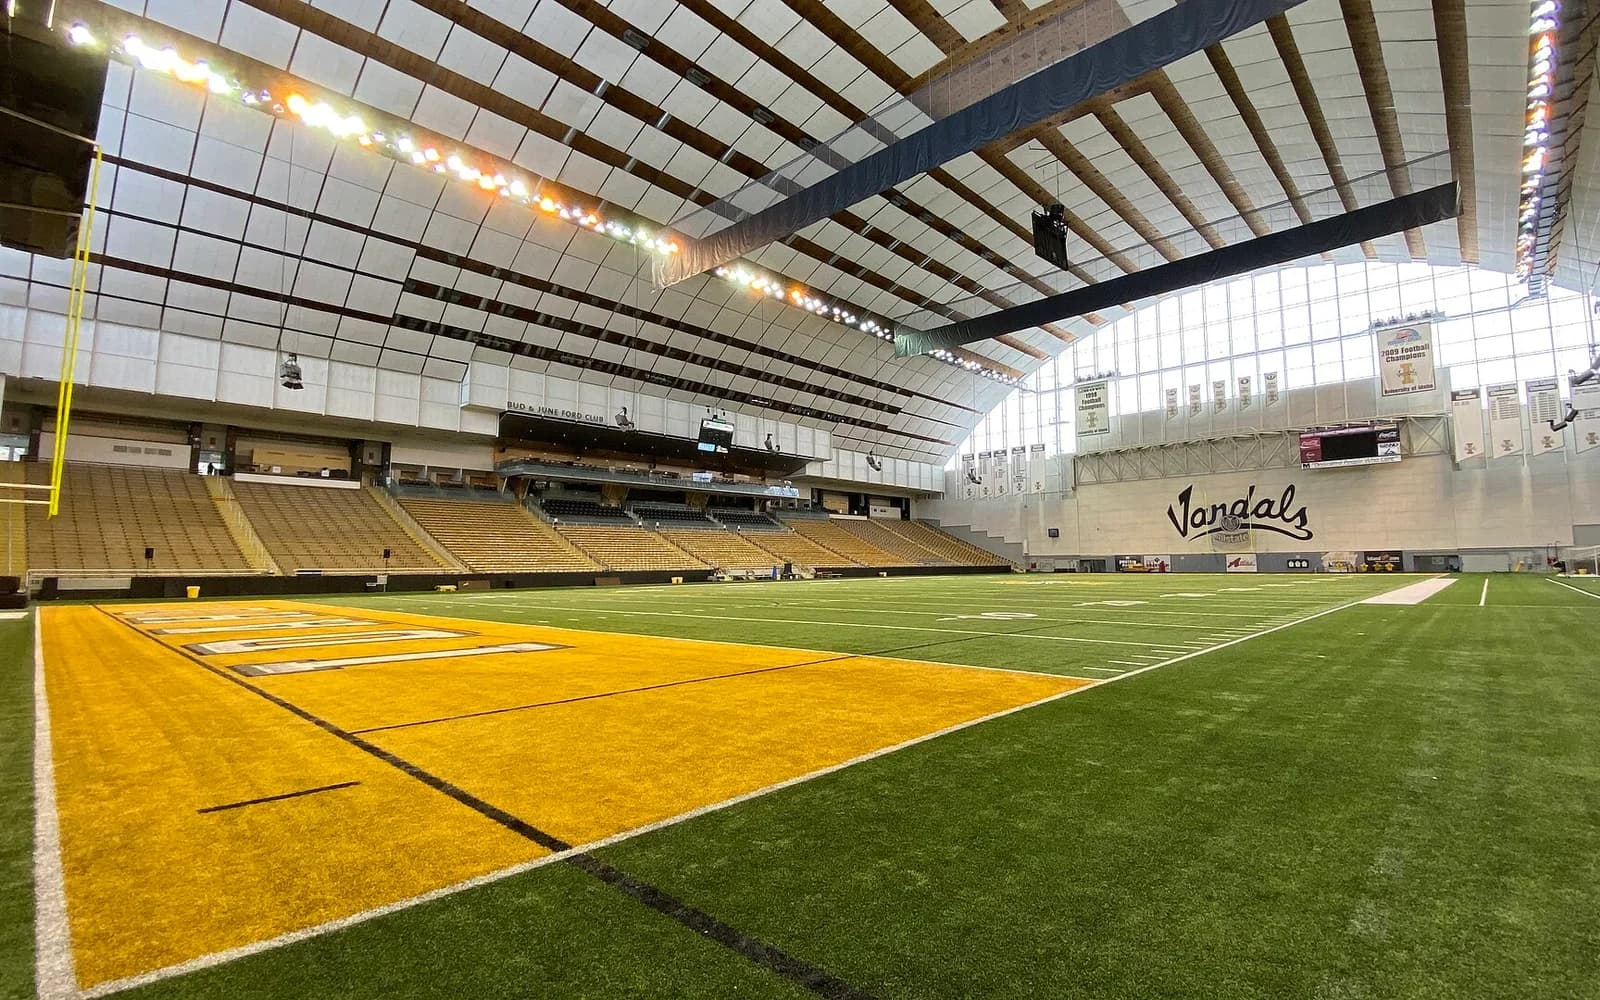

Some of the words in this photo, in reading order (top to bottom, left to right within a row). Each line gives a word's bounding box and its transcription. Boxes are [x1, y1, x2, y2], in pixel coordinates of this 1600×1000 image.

[1381, 348, 1398, 357] 2009
[1401, 344, 1429, 353] Football
[1386, 352, 1425, 362] Champions
[507, 401, 526, 409] BUD
[537, 407, 558, 416] JUNE
[561, 410, 582, 419] FORD
[585, 414, 604, 422] CLUB
[1167, 484, 1313, 541] Vandals
